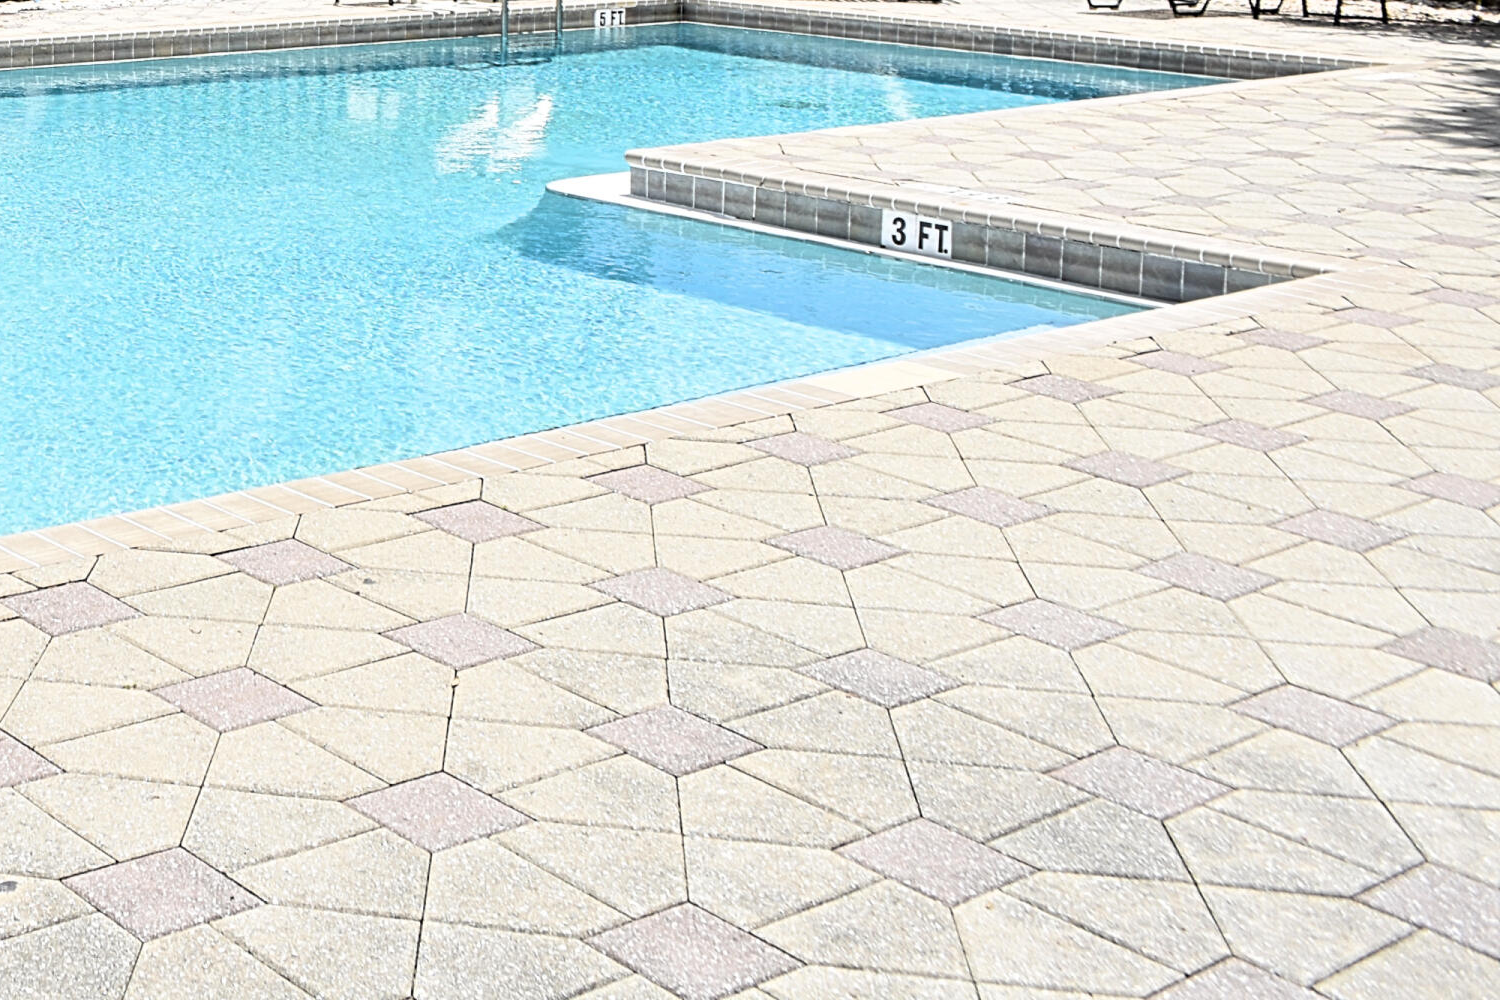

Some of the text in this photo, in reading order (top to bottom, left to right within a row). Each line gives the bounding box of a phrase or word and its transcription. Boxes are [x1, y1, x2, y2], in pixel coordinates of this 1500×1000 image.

[599, 12, 606, 26] 5
[891, 216, 949, 254] 3 FT.
